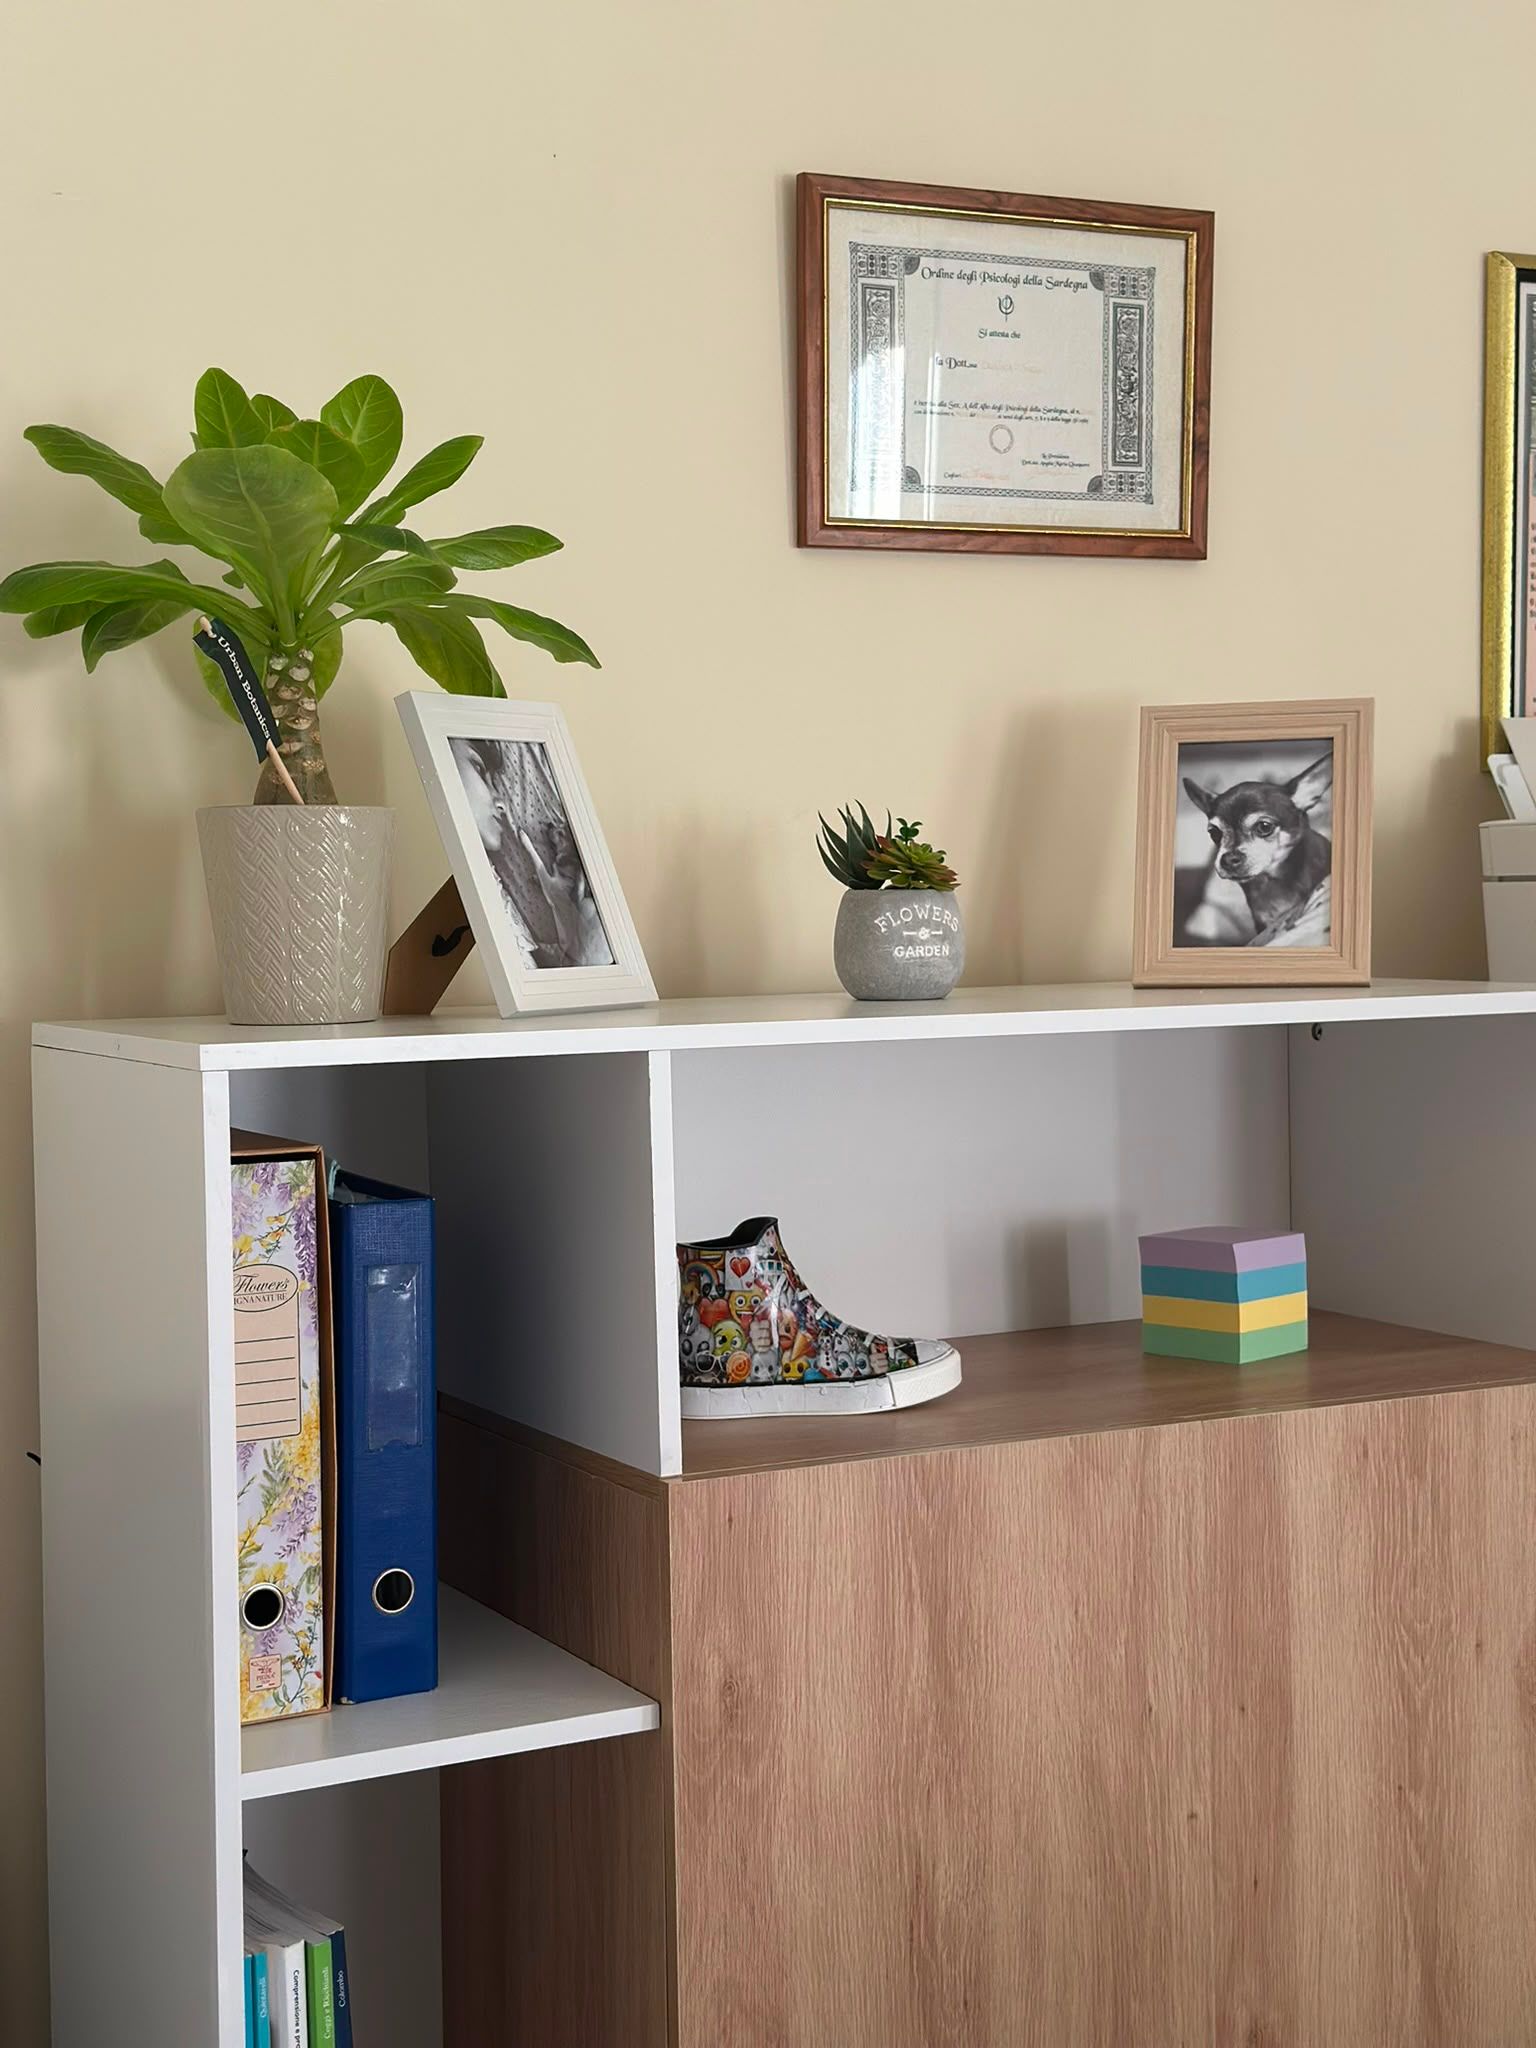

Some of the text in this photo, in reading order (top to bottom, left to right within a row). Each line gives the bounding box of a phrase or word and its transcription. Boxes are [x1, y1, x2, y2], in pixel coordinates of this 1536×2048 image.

[921, 266, 1088, 293] Ordine degli Psicologi della Sardegna
[217, 636, 271, 739] Urban Botanics
[874, 902, 959, 934] FLOWERS
[893, 944, 950, 959] GARDEN
[292, 1969, 302, 2027] Comprensione
[336, 1970, 346, 2008] Colombo
